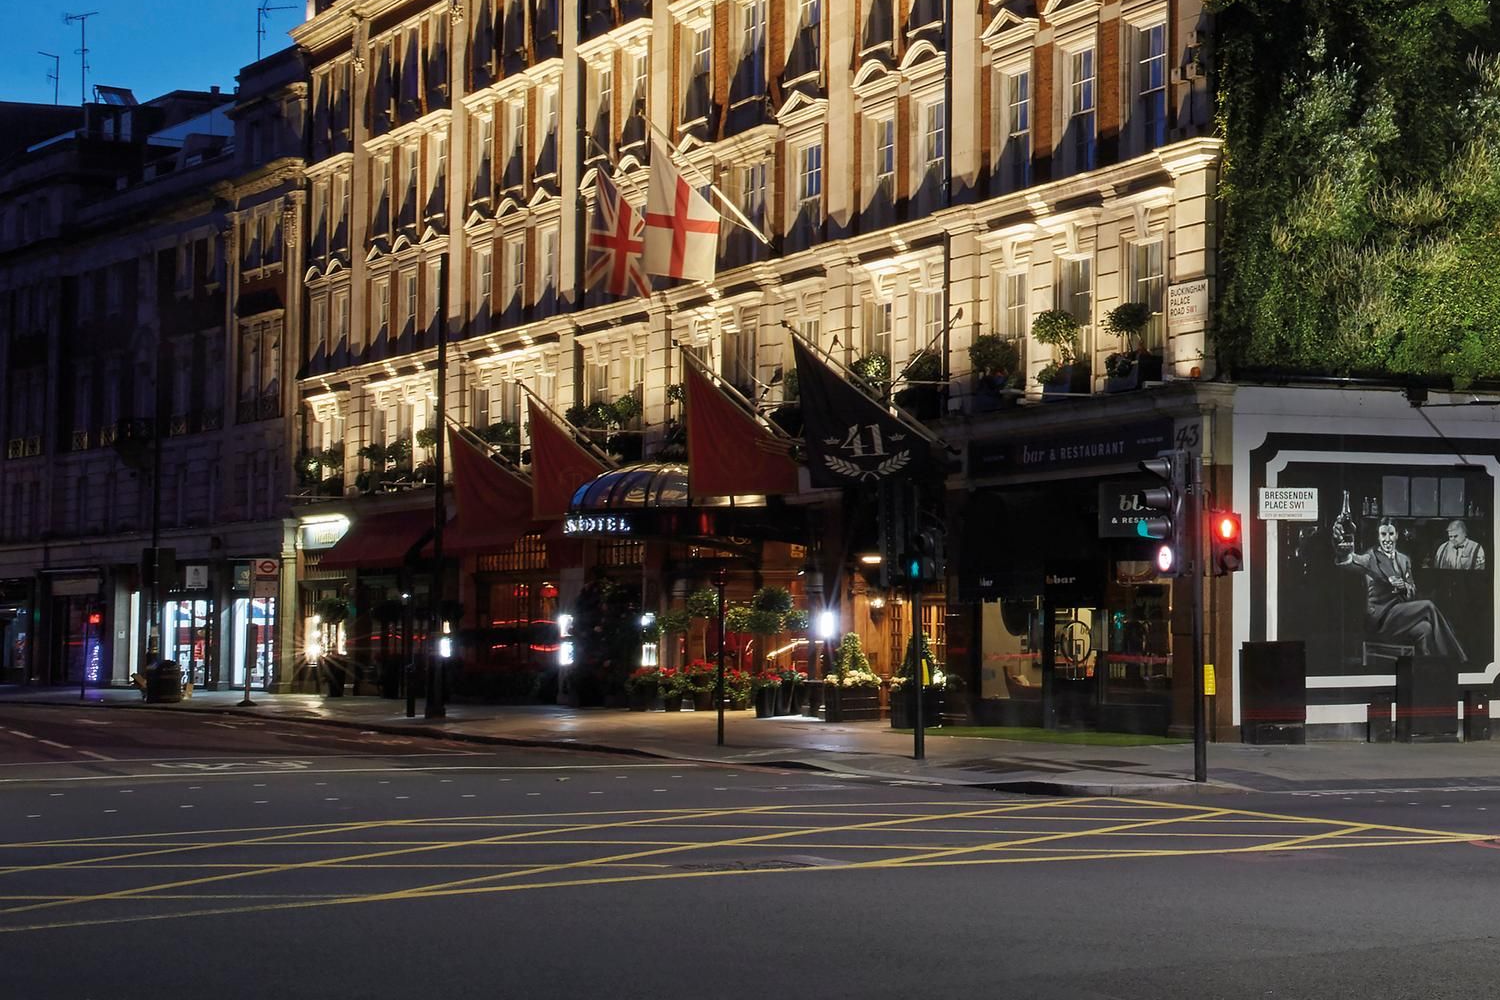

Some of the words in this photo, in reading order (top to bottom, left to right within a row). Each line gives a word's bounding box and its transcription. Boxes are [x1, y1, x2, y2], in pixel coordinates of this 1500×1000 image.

[1170, 283, 1206, 297] BUCKINGHAM
[1170, 296, 1190, 307] PALACE
[1170, 307, 1185, 317] ROAD
[1186, 305, 1198, 314] SW1
[841, 424, 890, 457] 41
[1175, 424, 1199, 449] 43
[1049, 448, 1056, 461] &
[1061, 441, 1124, 458] RESTAURANT
[1264, 491, 1314, 500] BRESSENDEN
[1264, 501, 1288, 509] PLACE
[1289, 501, 1305, 509] SW1
